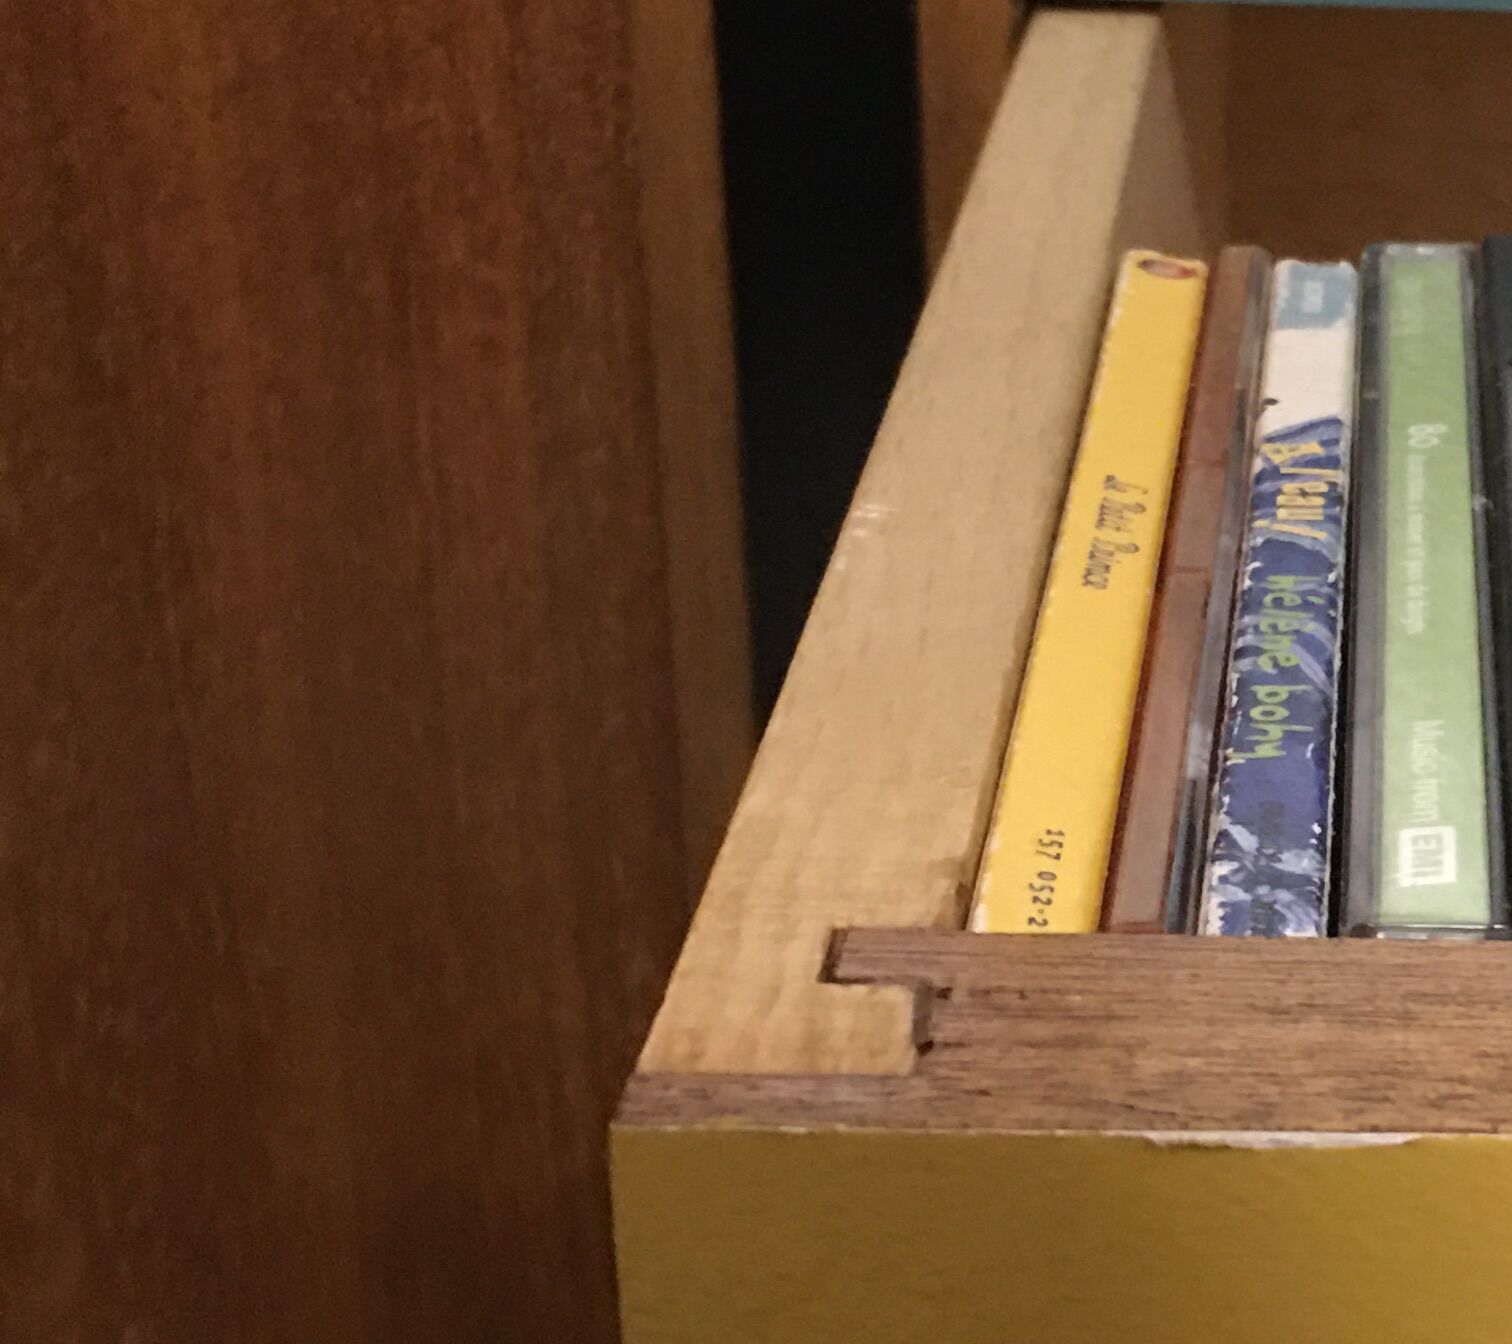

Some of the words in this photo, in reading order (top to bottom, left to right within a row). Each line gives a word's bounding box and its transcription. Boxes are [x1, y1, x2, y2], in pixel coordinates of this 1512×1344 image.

[1095, 497, 1148, 533] Petit
[1083, 537, 1141, 590] Prince
[1226, 685, 1315, 759] bohy
[1410, 718, 1447, 773] Music
[1035, 828, 1066, 861] 157
[1406, 830, 1447, 881] EMI
